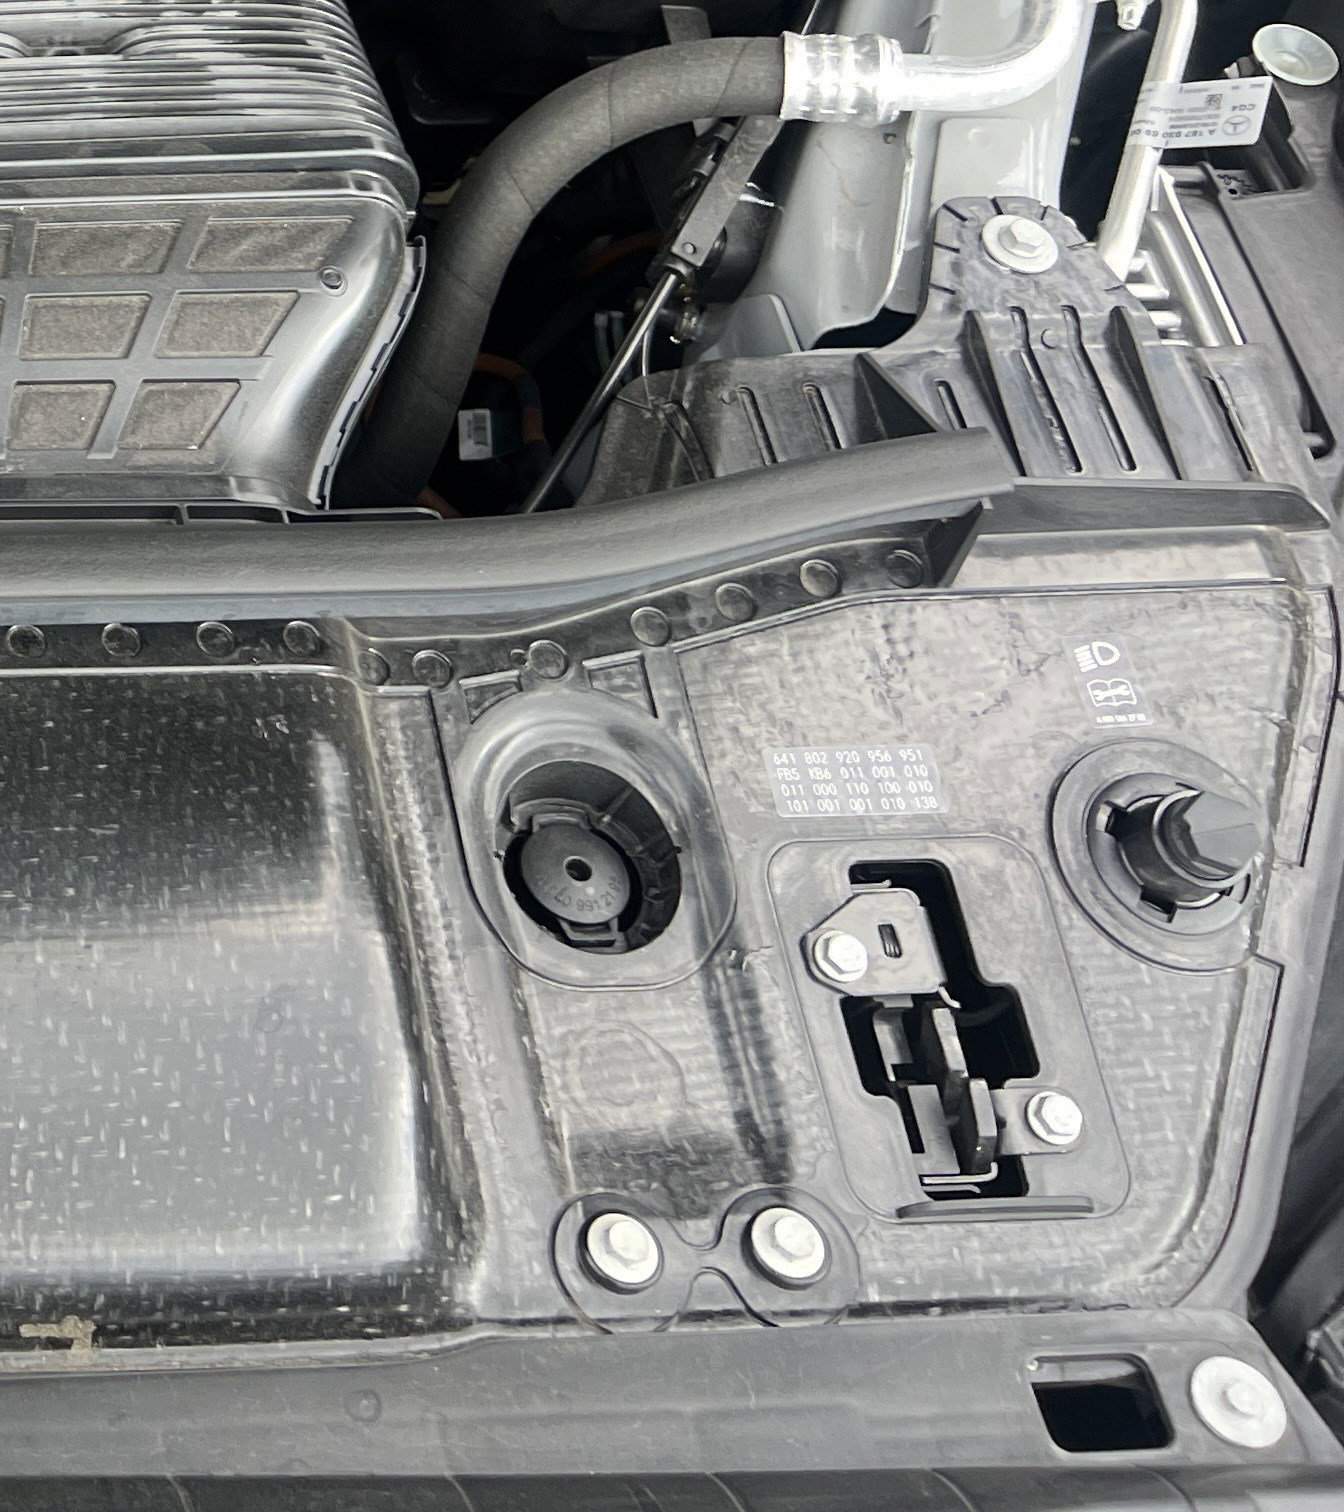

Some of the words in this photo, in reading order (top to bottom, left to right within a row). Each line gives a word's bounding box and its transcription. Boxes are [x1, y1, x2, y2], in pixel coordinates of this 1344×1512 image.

[773, 752, 796, 765] 641
[805, 752, 828, 764] 802
[836, 751, 860, 763] 920
[868, 750, 892, 763] 956
[899, 749, 922, 762] 951
[840, 767, 864, 779] 011
[872, 766, 895, 778] 001
[905, 765, 928, 777] 010
[781, 784, 804, 796] 011
[813, 783, 837, 796] 000
[846, 782, 869, 795] 110
[878, 782, 901, 794] 100
[909, 781, 933, 793] 010
[787, 800, 809, 812] 101
[817, 799, 840, 811] 001
[849, 799, 872, 811] 001
[881, 797, 905, 810] 010
[914, 797, 937, 809] 138
